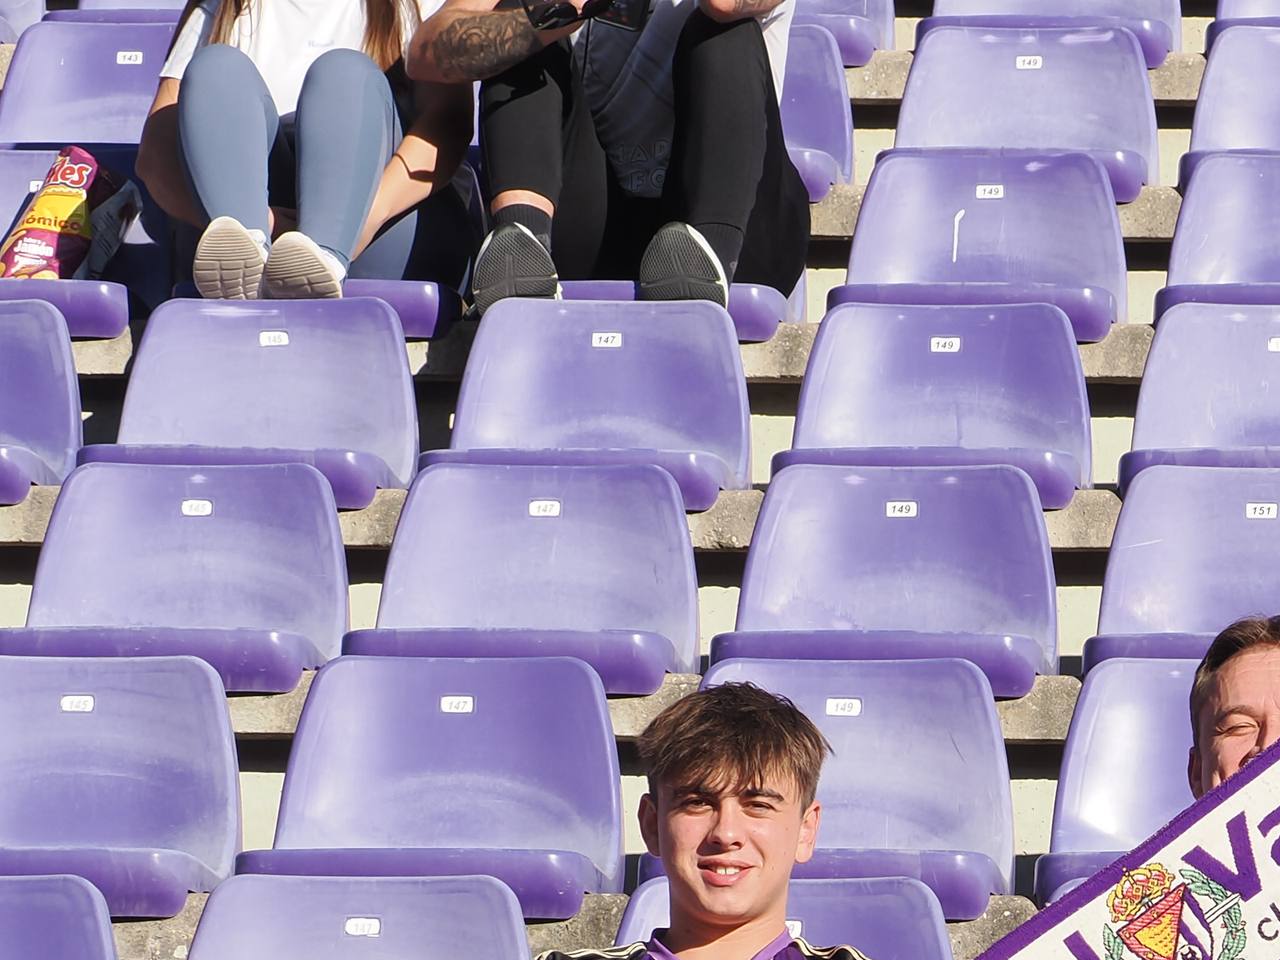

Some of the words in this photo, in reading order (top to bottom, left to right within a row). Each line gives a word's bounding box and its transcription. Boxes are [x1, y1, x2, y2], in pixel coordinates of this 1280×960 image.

[1022, 58, 1037, 66] 149
[892, 505, 910, 513] 149
[1253, 507, 1270, 515] 151
[449, 701, 467, 709] 147
[835, 703, 853, 712] 149
